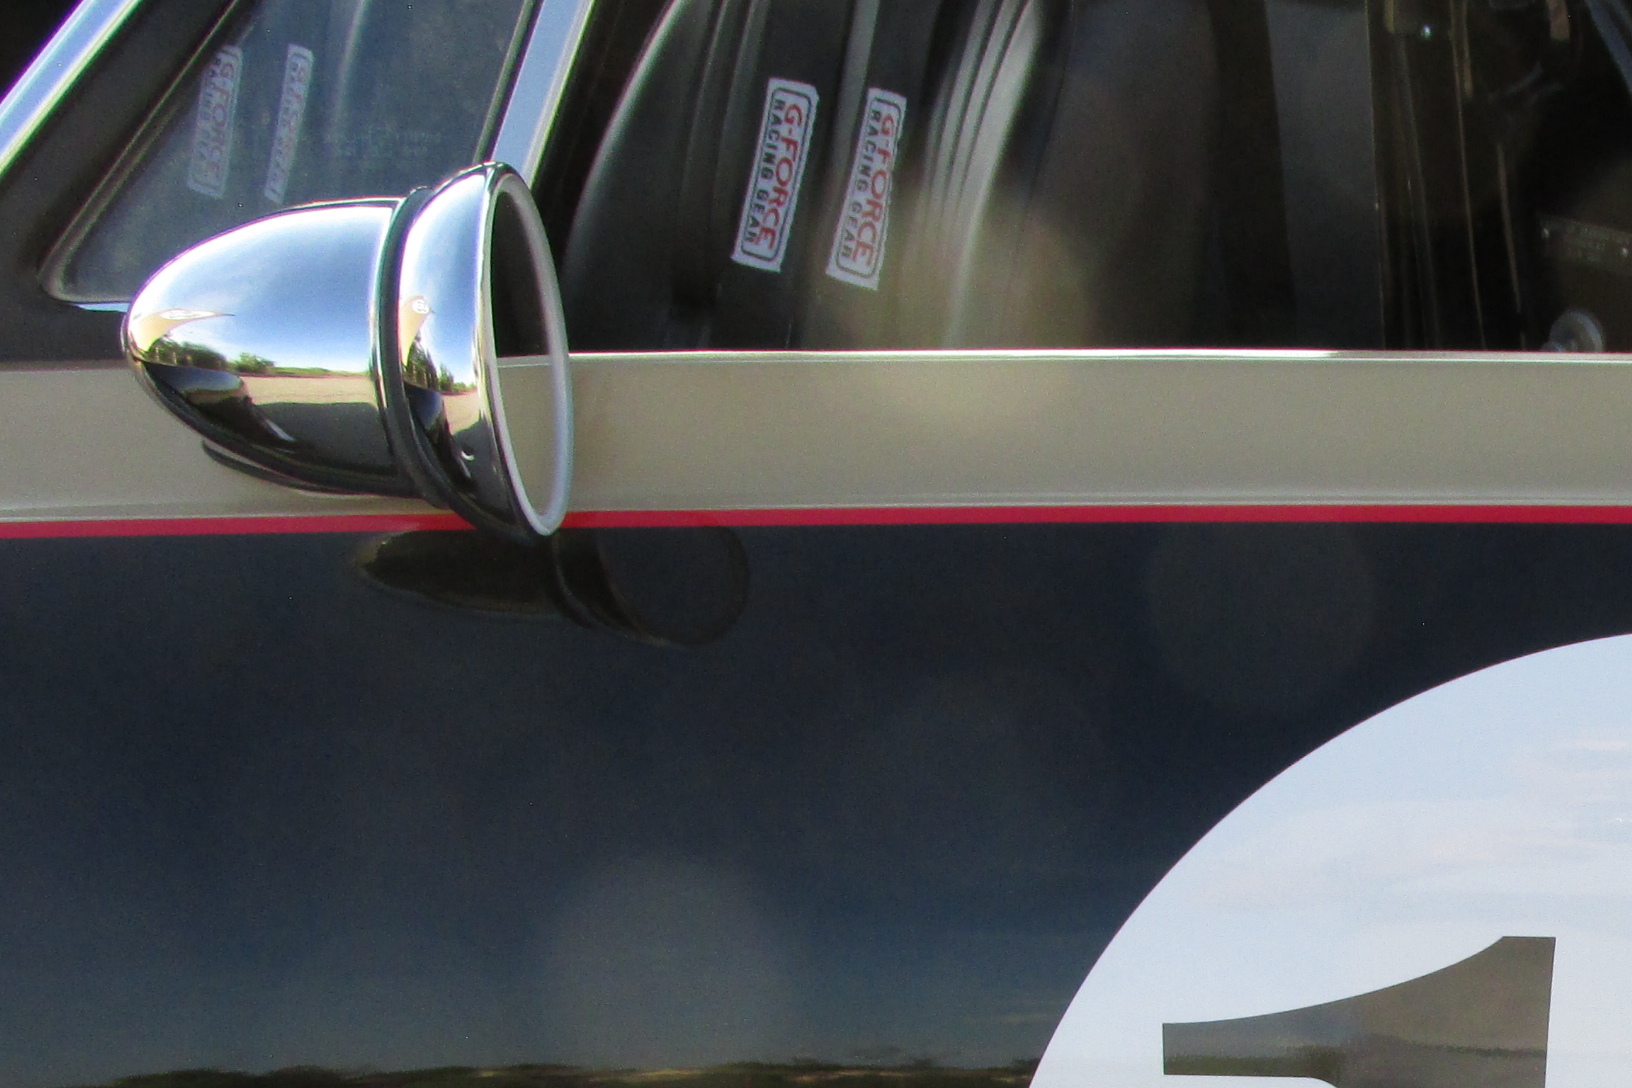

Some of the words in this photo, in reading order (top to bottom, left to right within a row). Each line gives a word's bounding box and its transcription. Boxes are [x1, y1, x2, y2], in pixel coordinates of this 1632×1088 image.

[755, 104, 803, 250] G-FORCE
[761, 100, 786, 180] RACING
[855, 109, 881, 192] RACING
[746, 190, 768, 242] GEAR
[841, 201, 863, 259] GEAR
[851, 113, 893, 266] G-FORCE
